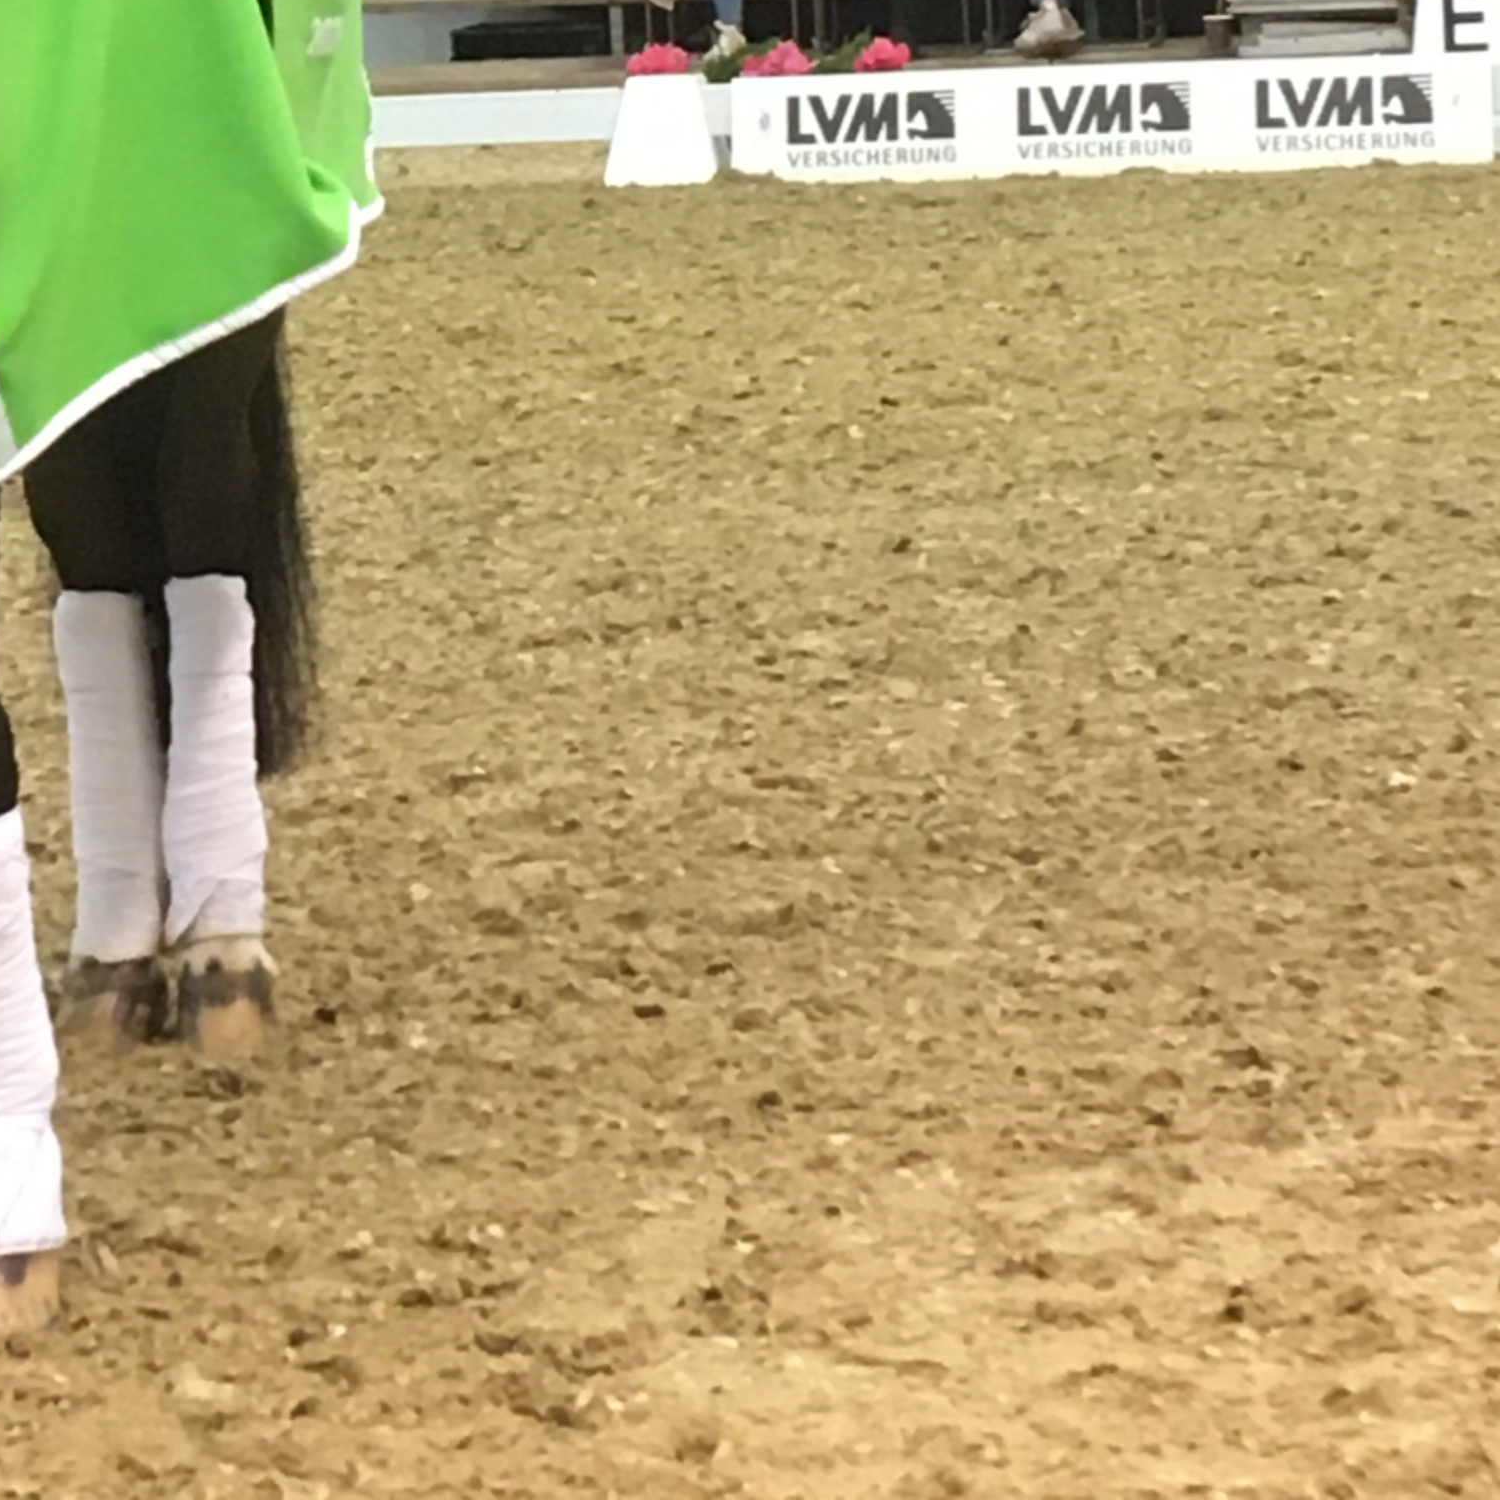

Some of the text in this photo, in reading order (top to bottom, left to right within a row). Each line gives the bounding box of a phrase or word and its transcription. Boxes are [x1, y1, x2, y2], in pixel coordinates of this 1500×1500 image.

[786, 92, 900, 145] LVM
[1016, 84, 1133, 136] LVM
[1255, 76, 1374, 129] LVM
[786, 145, 958, 169] VERSICHERUNG
[1017, 137, 1193, 160] VERSICHERUNG
[1256, 131, 1436, 153] VERSICHERUNG
